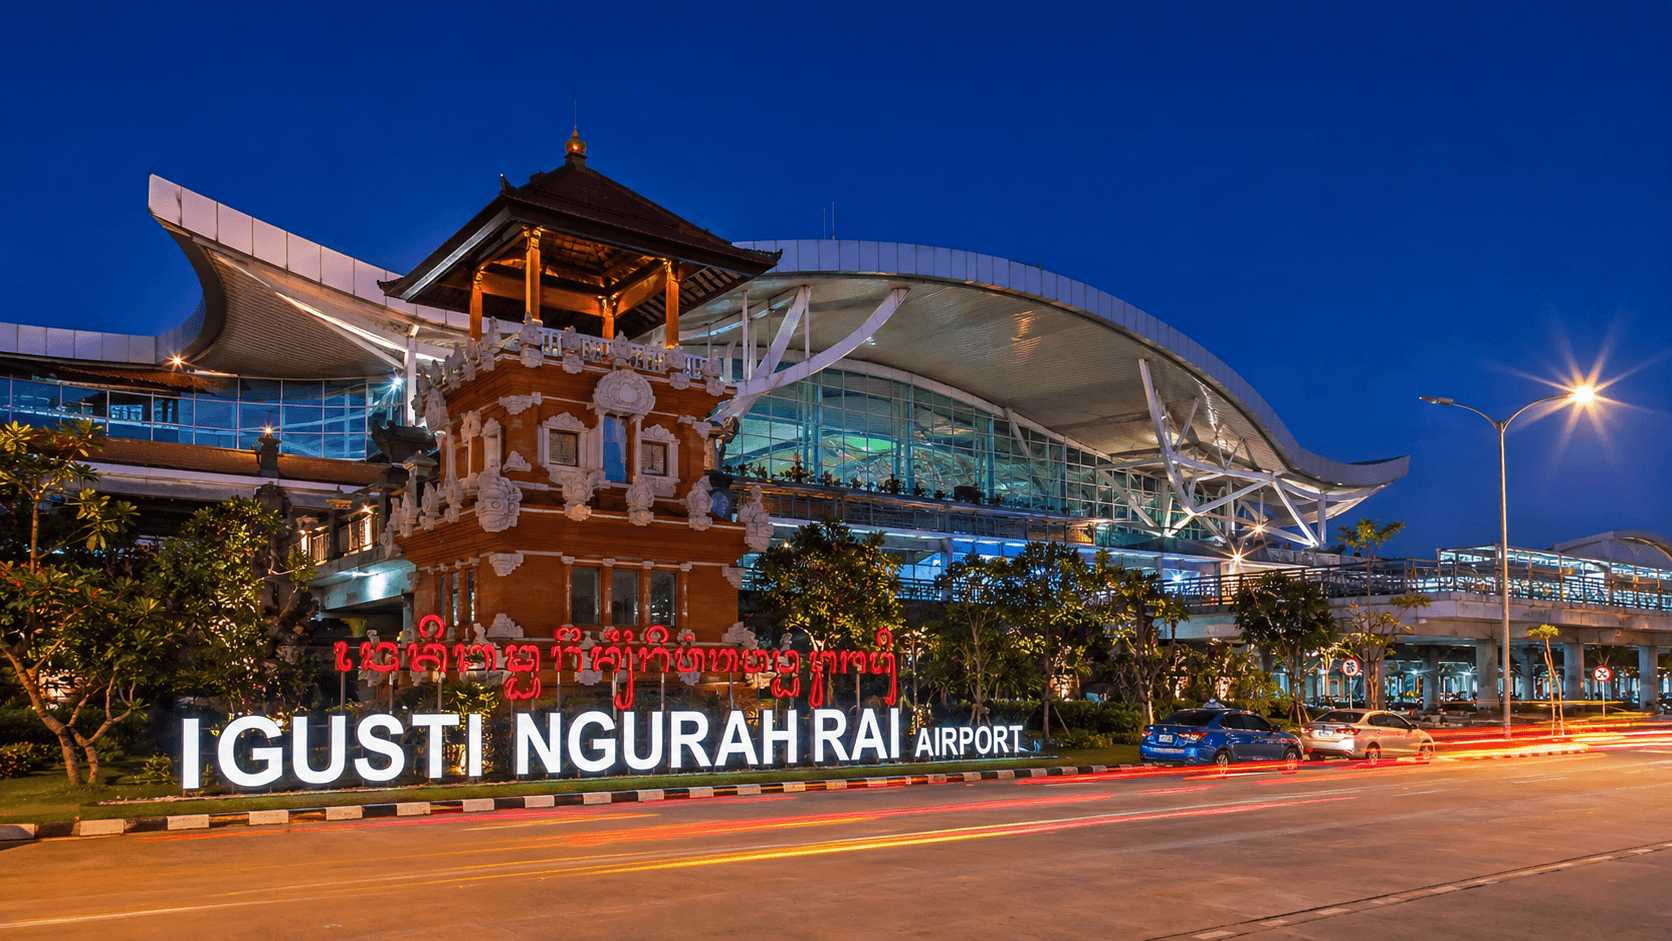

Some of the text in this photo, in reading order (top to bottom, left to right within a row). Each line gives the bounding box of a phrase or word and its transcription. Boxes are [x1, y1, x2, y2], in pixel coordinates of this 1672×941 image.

[182, 707, 1023, 790] I GUSTI NGURAH RAI AIRPORT
